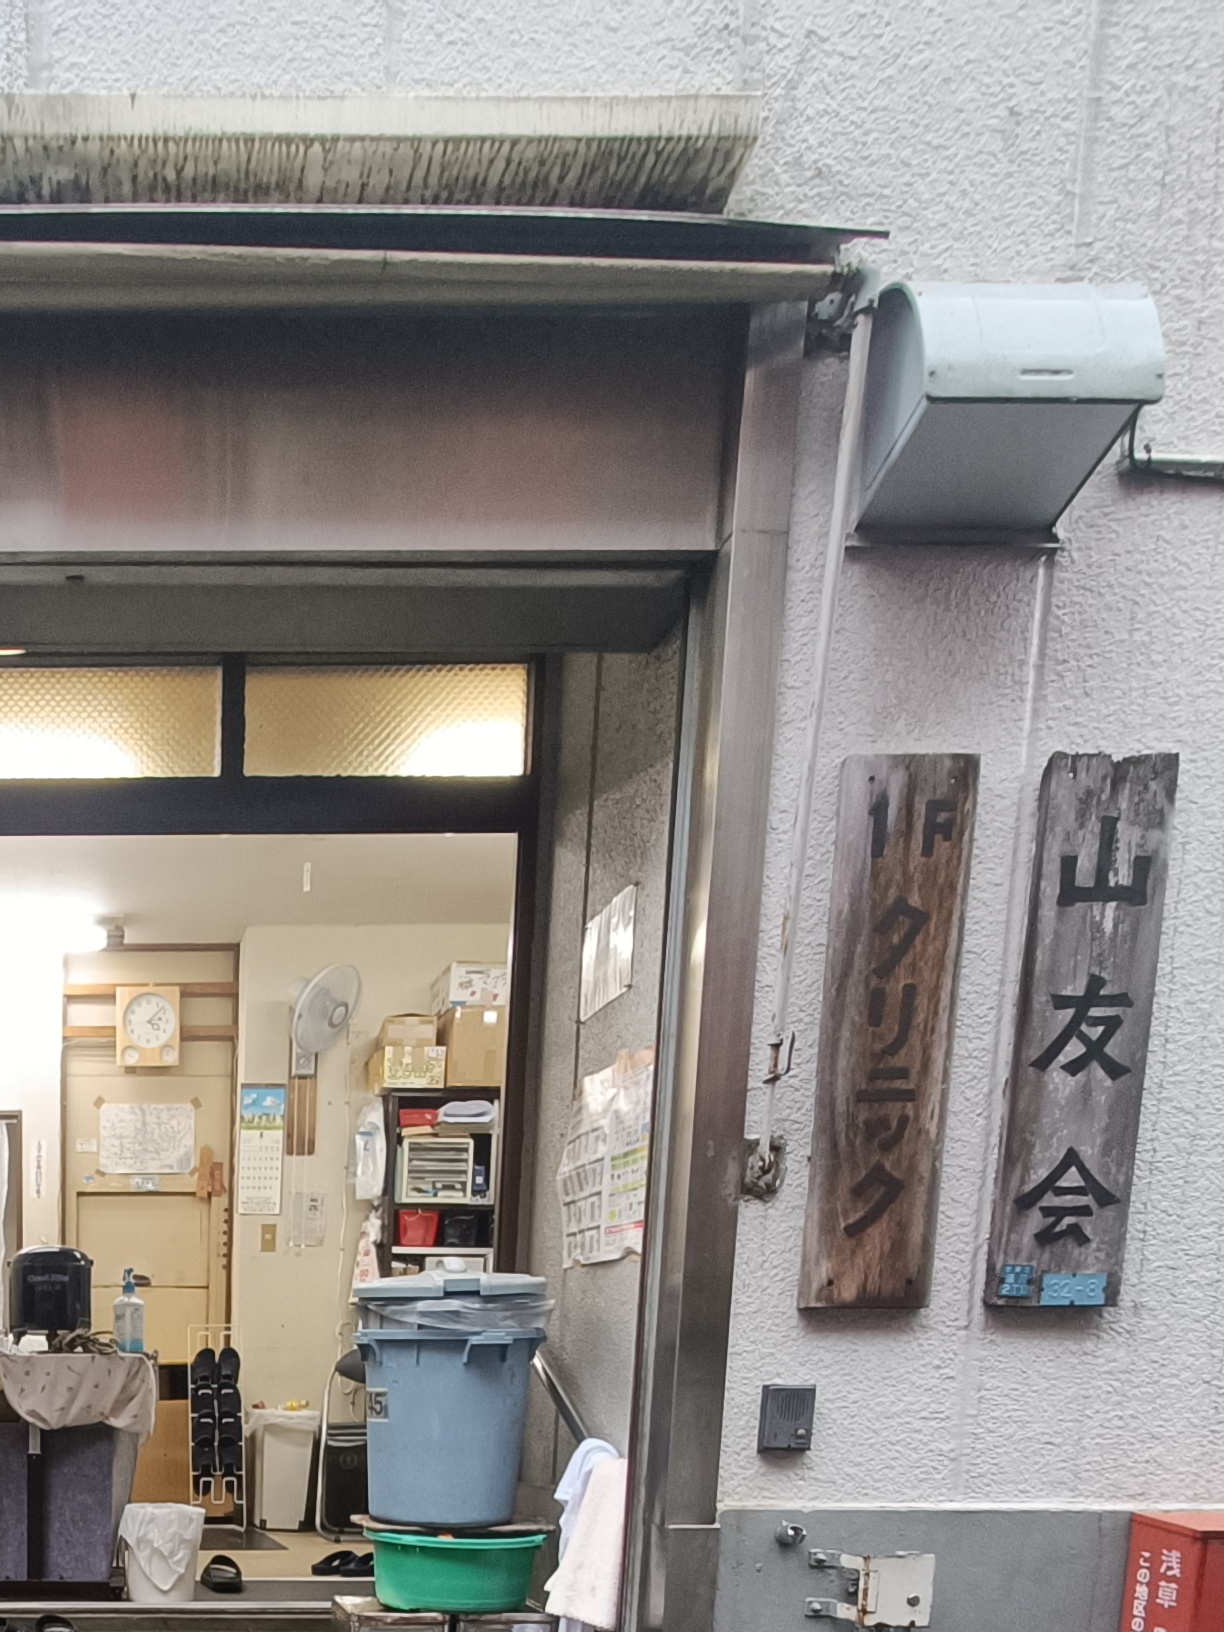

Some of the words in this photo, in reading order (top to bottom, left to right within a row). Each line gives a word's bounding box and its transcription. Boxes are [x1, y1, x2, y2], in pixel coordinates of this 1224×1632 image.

[868, 793, 958, 859] 1F
[842, 894, 929, 1239] クリニック
[1014, 815, 1153, 1248] 山友会
